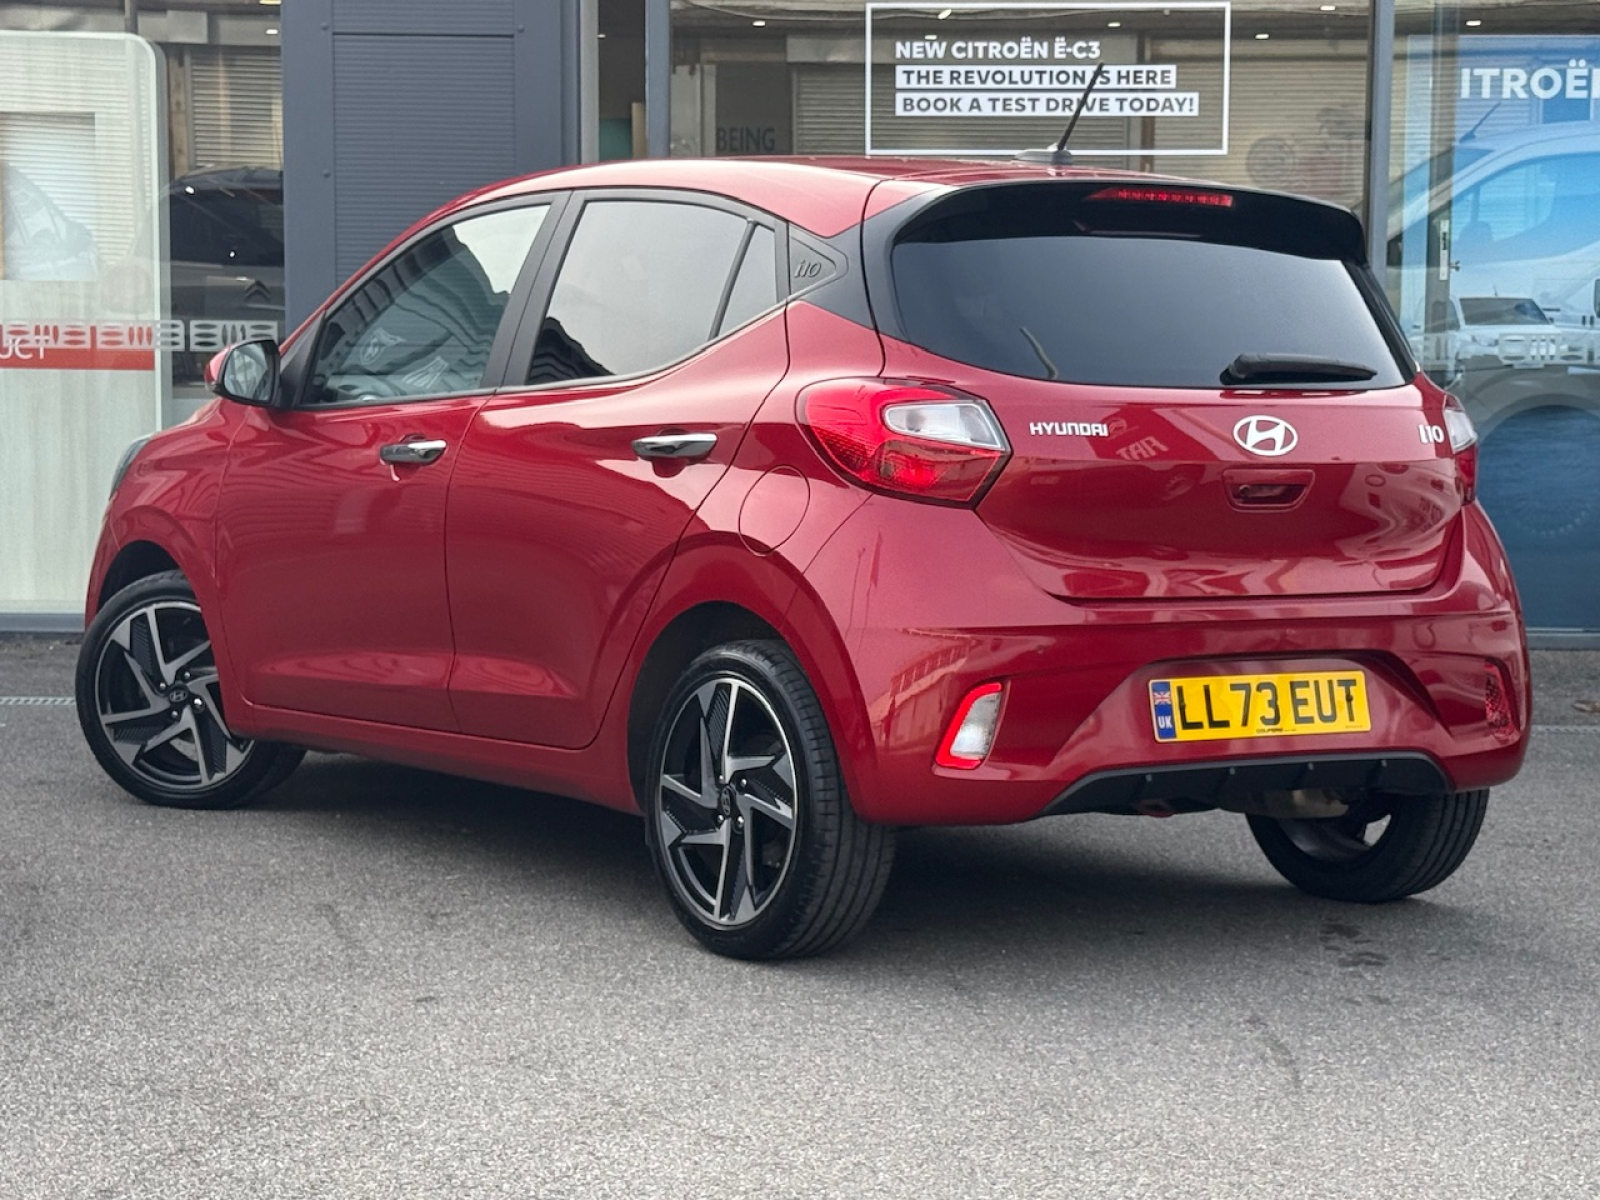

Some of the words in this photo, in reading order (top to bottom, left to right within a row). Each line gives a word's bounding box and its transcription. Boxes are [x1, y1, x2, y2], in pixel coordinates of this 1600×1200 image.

[895, 41, 946, 59] NEW
[951, 38, 1048, 59] CITROËN
[1053, 38, 1101, 59] Ë-C3
[902, 70, 943, 85] THE
[949, 70, 1086, 85] REVOLUTION
[1117, 70, 1172, 85] HERE
[1460, 59, 1600, 99] ITROË
[902, 97, 962, 112] BOOK
[967, 97, 982, 112] A
[987, 97, 1040, 112] TEST
[1114, 97, 1195, 112] TODAY!
[715, 127, 774, 152] BEING
[1029, 422, 1109, 436] HYUNDAI
[1176, 682, 1281, 731] LL73
[1290, 679, 1357, 725] EUT
[1157, 715, 1173, 729] UK
